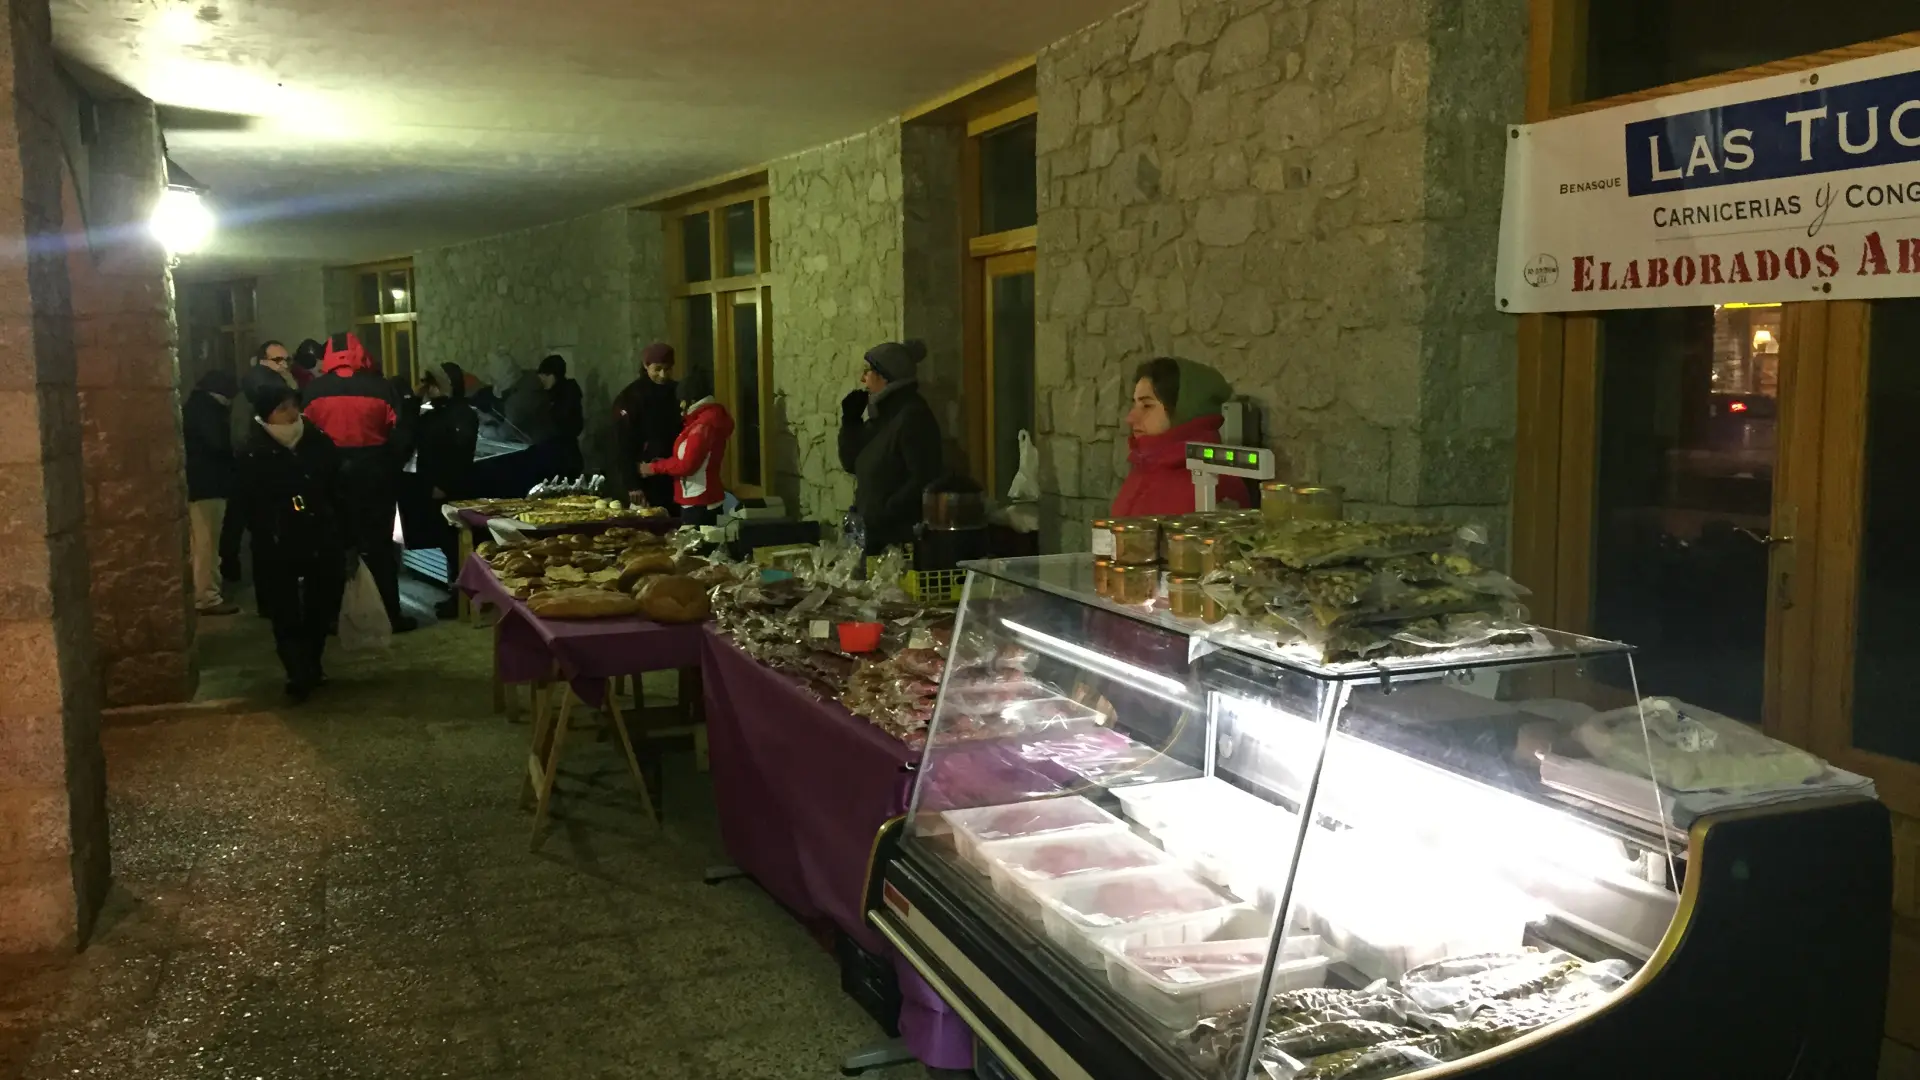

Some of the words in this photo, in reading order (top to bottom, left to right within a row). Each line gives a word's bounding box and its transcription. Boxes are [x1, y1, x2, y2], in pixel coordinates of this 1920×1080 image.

[1648, 128, 1755, 182] LAS
[1559, 177, 1622, 194] BENASQUE
[1653, 195, 1802, 228] CARNICERIAS
[1845, 181, 1920, 208] CONG
[1571, 244, 1840, 292] ELABORADOS
